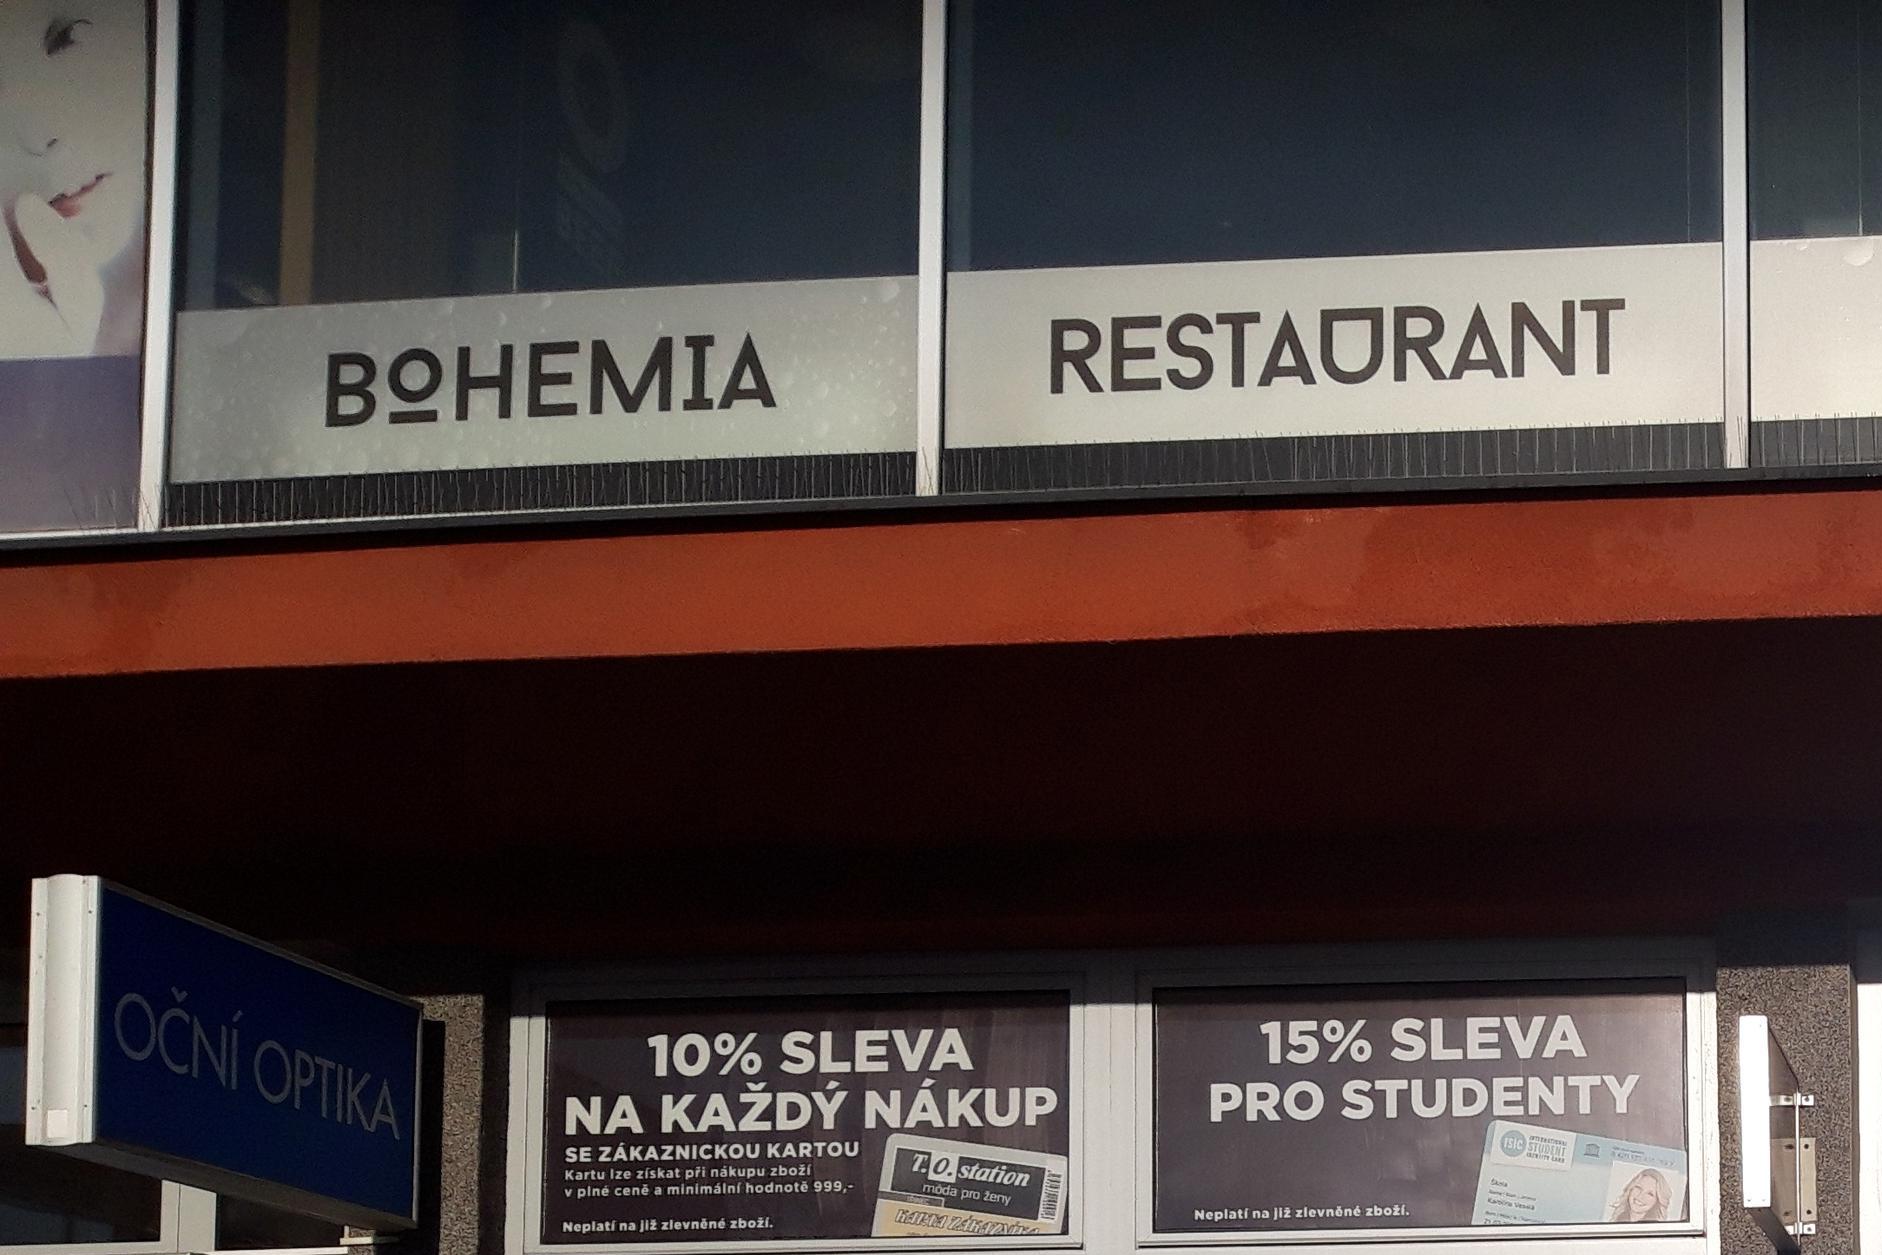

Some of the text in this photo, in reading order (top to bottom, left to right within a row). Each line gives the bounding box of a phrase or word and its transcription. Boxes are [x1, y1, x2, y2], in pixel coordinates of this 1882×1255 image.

[1050, 298, 1626, 395] RESTAURANT
[325, 333, 777, 428] BOHEMIA
[1260, 1015, 1588, 1064] 15% SLEVA
[114, 986, 400, 1141] OČNÍ OPTIKA
[647, 1028, 975, 1077] 10% SLEVA
[565, 1079, 1058, 1135] NA KAŽDÝ NÁKUP
[1209, 1074, 1641, 1123] PRO STUDENTY
[565, 1141, 860, 1163] SE ZÁKAZNICKOU KARTOU
[1527, 1142, 1567, 1157] STUDENT
[565, 1164, 812, 1183] Kartu lze získat při nákupu zboží
[957, 1163, 1031, 1187] station
[564, 1188, 572, 1198] v
[577, 1185, 609, 1199] plné
[614, 1184, 650, 1197] ceně
[654, 1186, 662, 1196] a
[667, 1182, 742, 1196] minimální
[745, 1181, 809, 1194] hodnotě
[922, 1182, 1012, 1207] móda pro ženy
[562, 1216, 774, 1235] Neplatí na již zlevněné zboží.
[1194, 1203, 1410, 1223] Neplatí na již zlevněné zboží.
